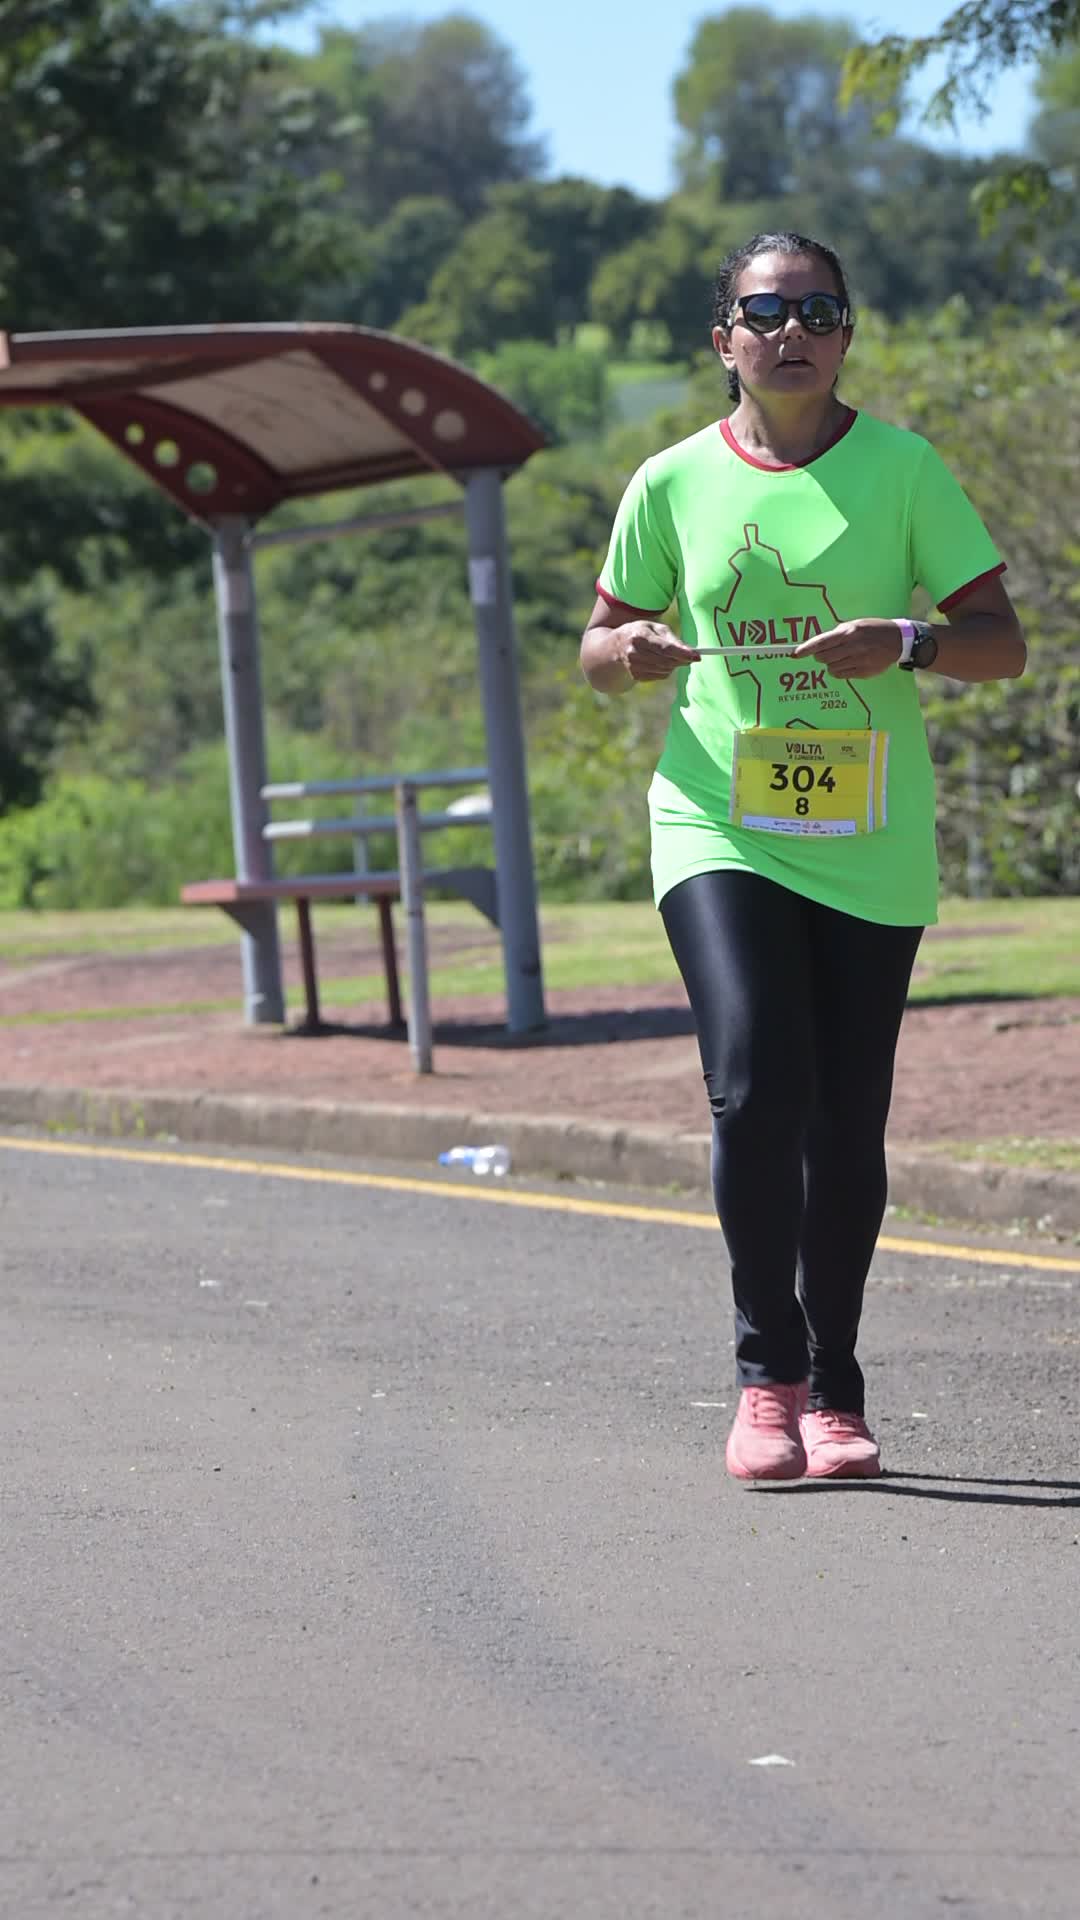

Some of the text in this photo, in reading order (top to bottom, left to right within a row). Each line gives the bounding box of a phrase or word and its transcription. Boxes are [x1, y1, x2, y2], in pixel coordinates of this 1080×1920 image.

[727, 615, 823, 646] VOLTA
[779, 669, 828, 692] 92K
[778, 691, 840, 702] REVEZAMENTO
[821, 699, 848, 710] 2026
[785, 742, 822, 755] VOLTA
[769, 763, 836, 793] 304
[795, 797, 809, 816] 8
